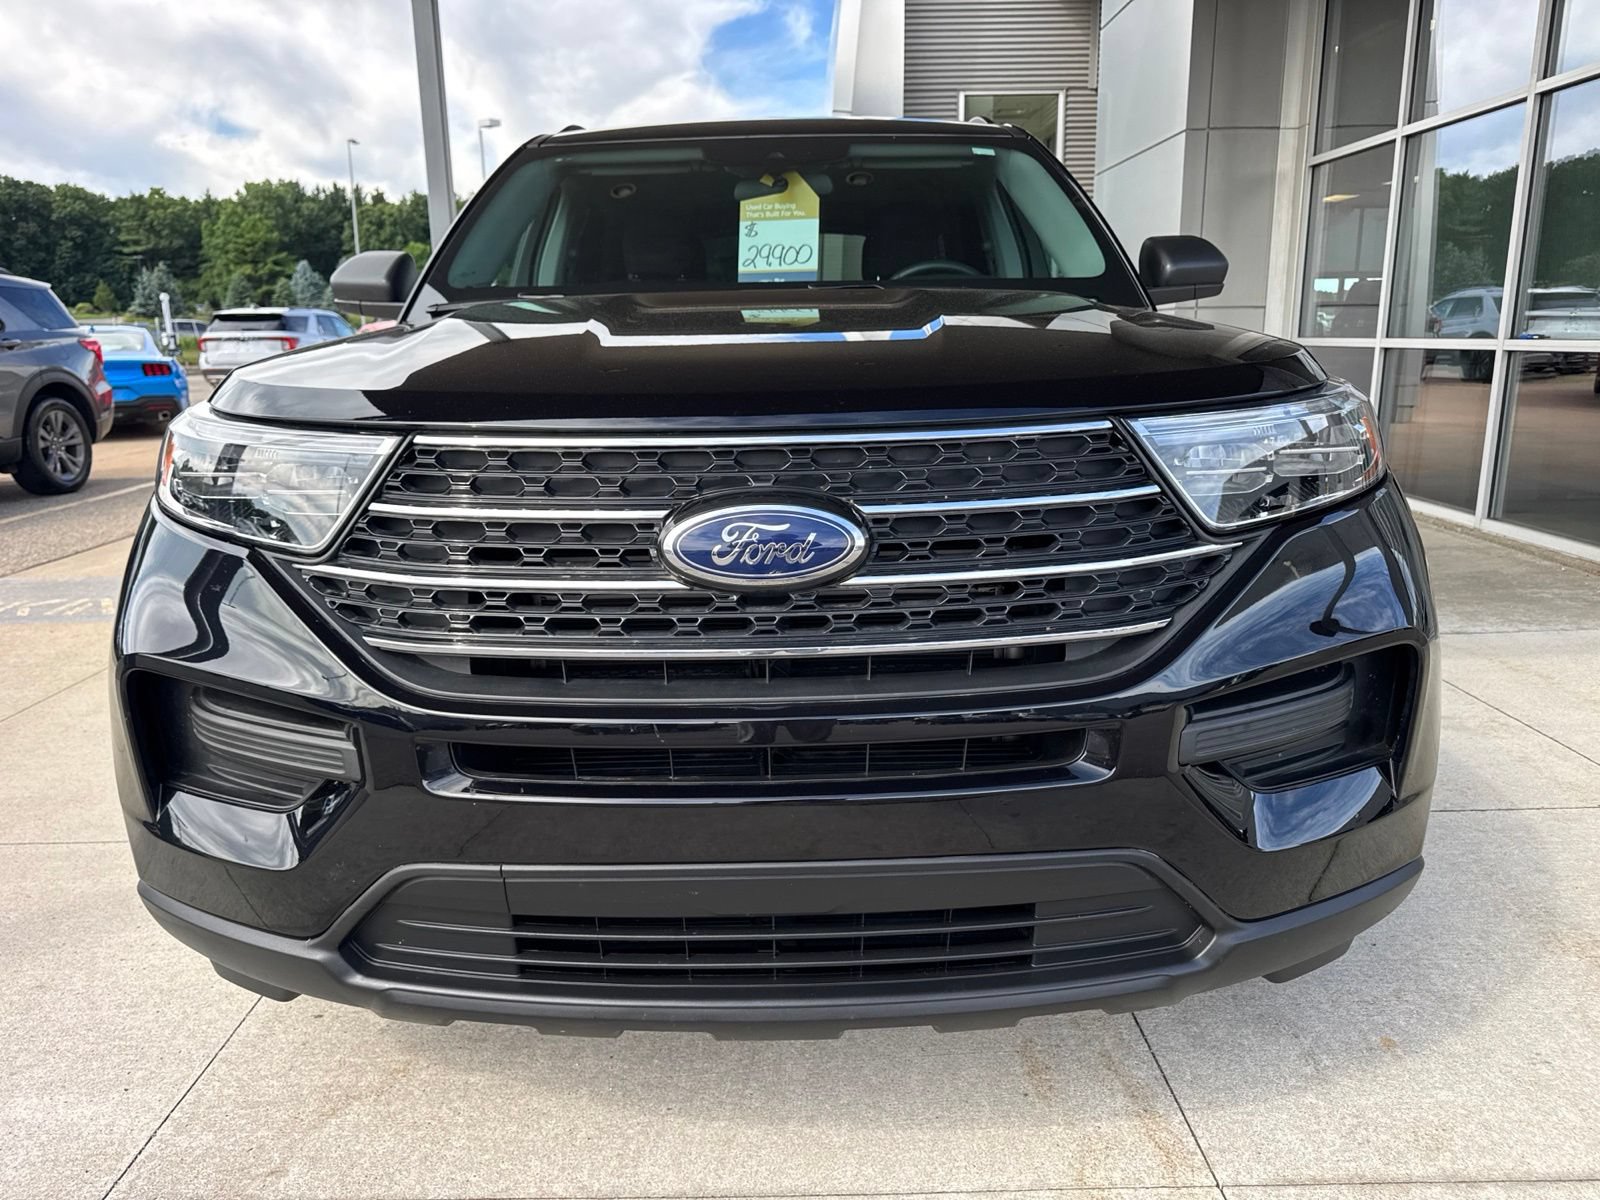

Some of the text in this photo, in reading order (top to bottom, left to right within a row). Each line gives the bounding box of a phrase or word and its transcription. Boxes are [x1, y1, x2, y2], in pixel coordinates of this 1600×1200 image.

[774, 203, 796, 211] Buying
[745, 221, 758, 238] $
[711, 522, 817, 566] Ford
